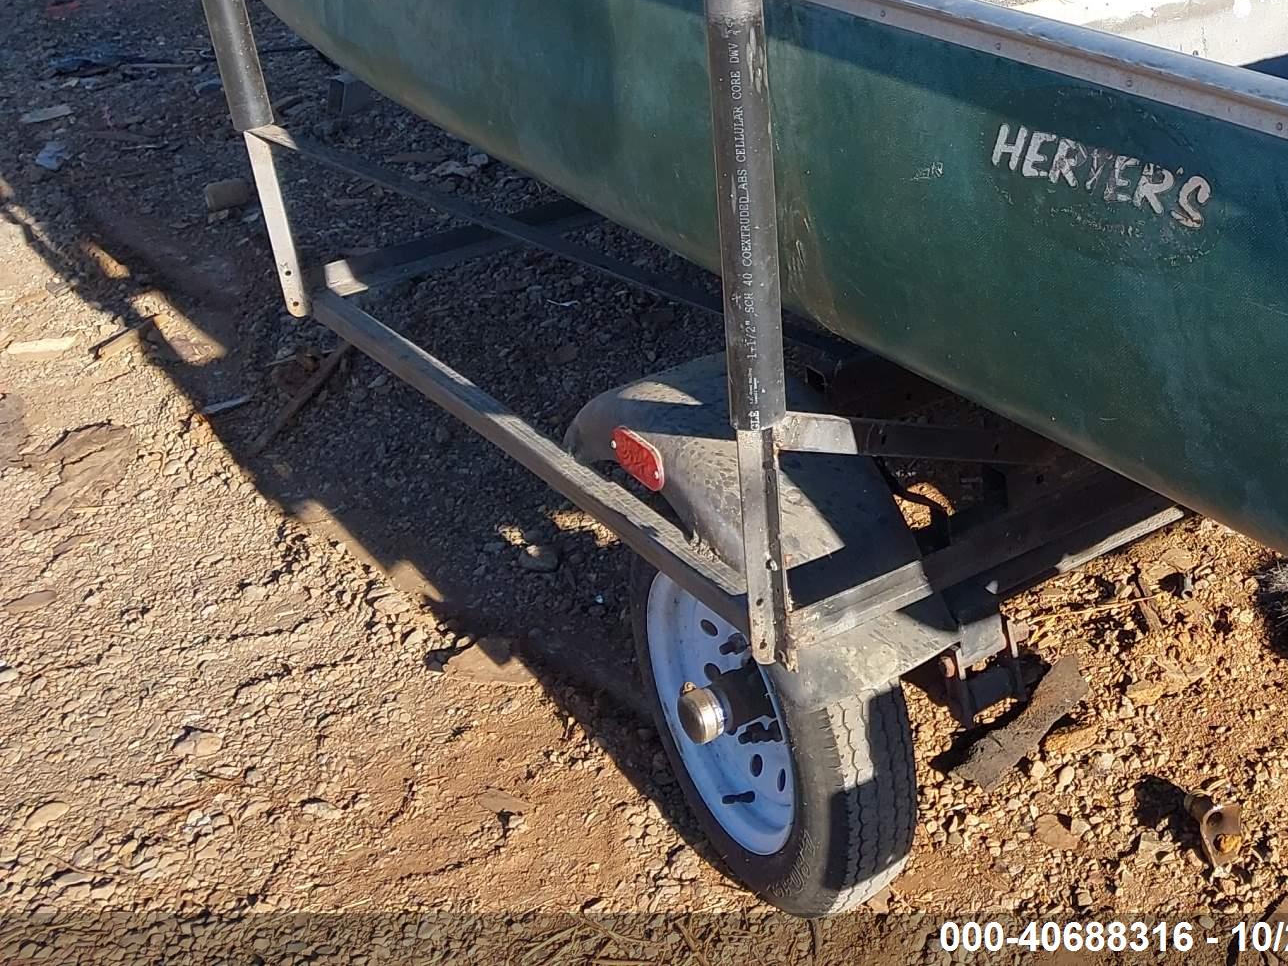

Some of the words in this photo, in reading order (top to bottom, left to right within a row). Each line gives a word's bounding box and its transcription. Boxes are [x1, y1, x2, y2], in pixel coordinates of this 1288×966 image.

[728, 42, 740, 64] DWV
[730, 70, 742, 100] CORE
[733, 105, 746, 163] CELLULAR
[737, 169, 749, 191] ABS
[739, 196, 752, 267] COEXTRUDED
[743, 273, 753, 287] 40
[744, 292, 755, 314] SCH
